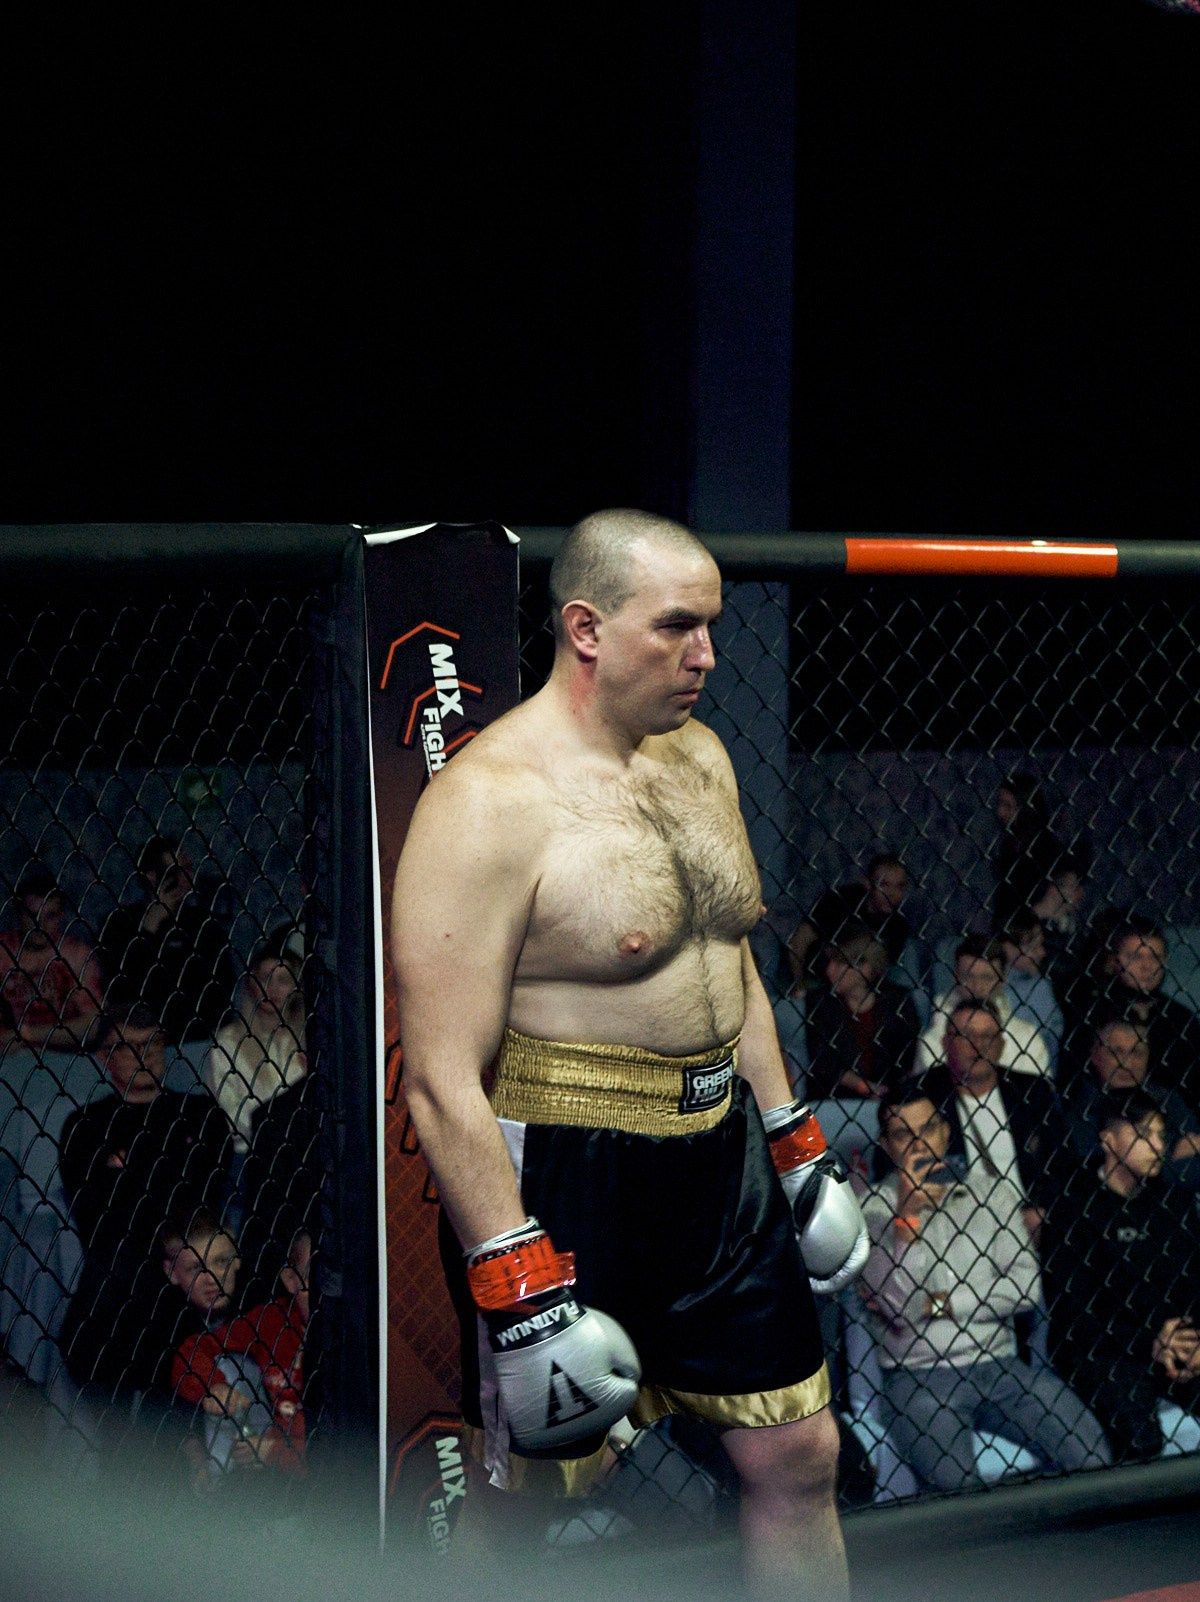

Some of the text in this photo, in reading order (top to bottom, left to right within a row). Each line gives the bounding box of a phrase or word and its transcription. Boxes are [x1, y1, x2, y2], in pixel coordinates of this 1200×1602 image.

[428, 643, 464, 718] MIX
[496, 1299, 580, 1348] PLATINUM
[435, 1436, 467, 1506] MIX
